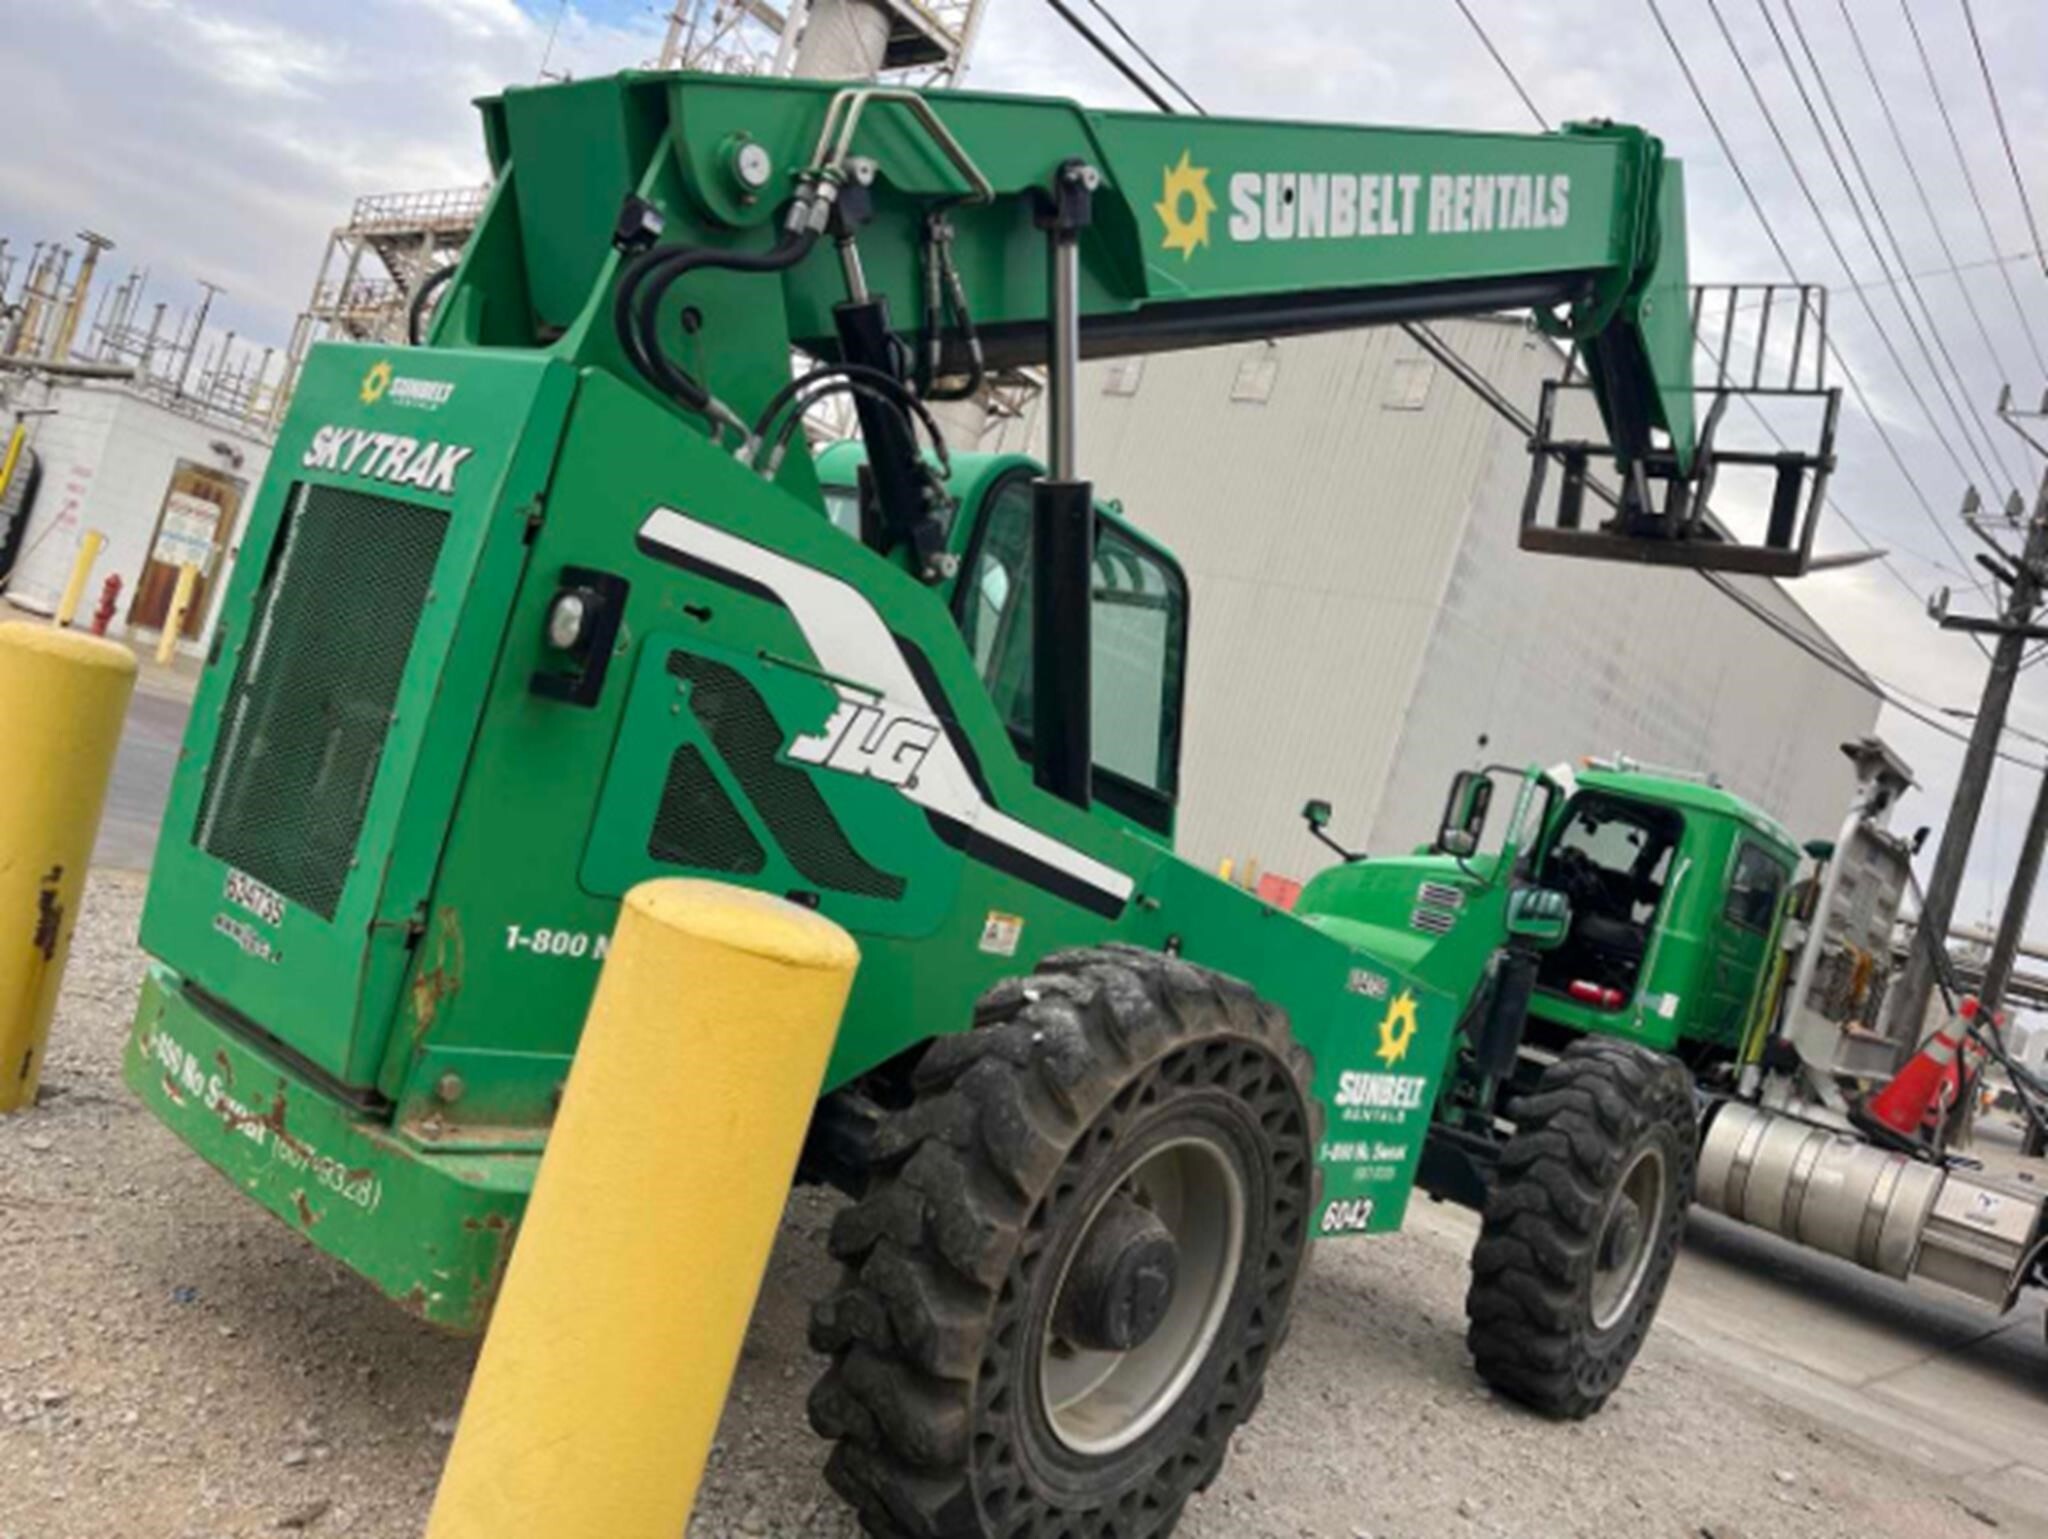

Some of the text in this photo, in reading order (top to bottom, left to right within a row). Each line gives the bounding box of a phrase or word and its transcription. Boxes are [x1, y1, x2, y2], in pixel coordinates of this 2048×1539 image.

[1229, 172, 1570, 241] SUNBELT RENTALS
[303, 425, 473, 496] SKYTRAK
[786, 697, 941, 790] JLG
[506, 925, 589, 957] 1-800
[181, 1050, 206, 1097] No
[1335, 1071, 1426, 1108] SUNBELT
[1322, 1199, 1373, 1232] 6042
